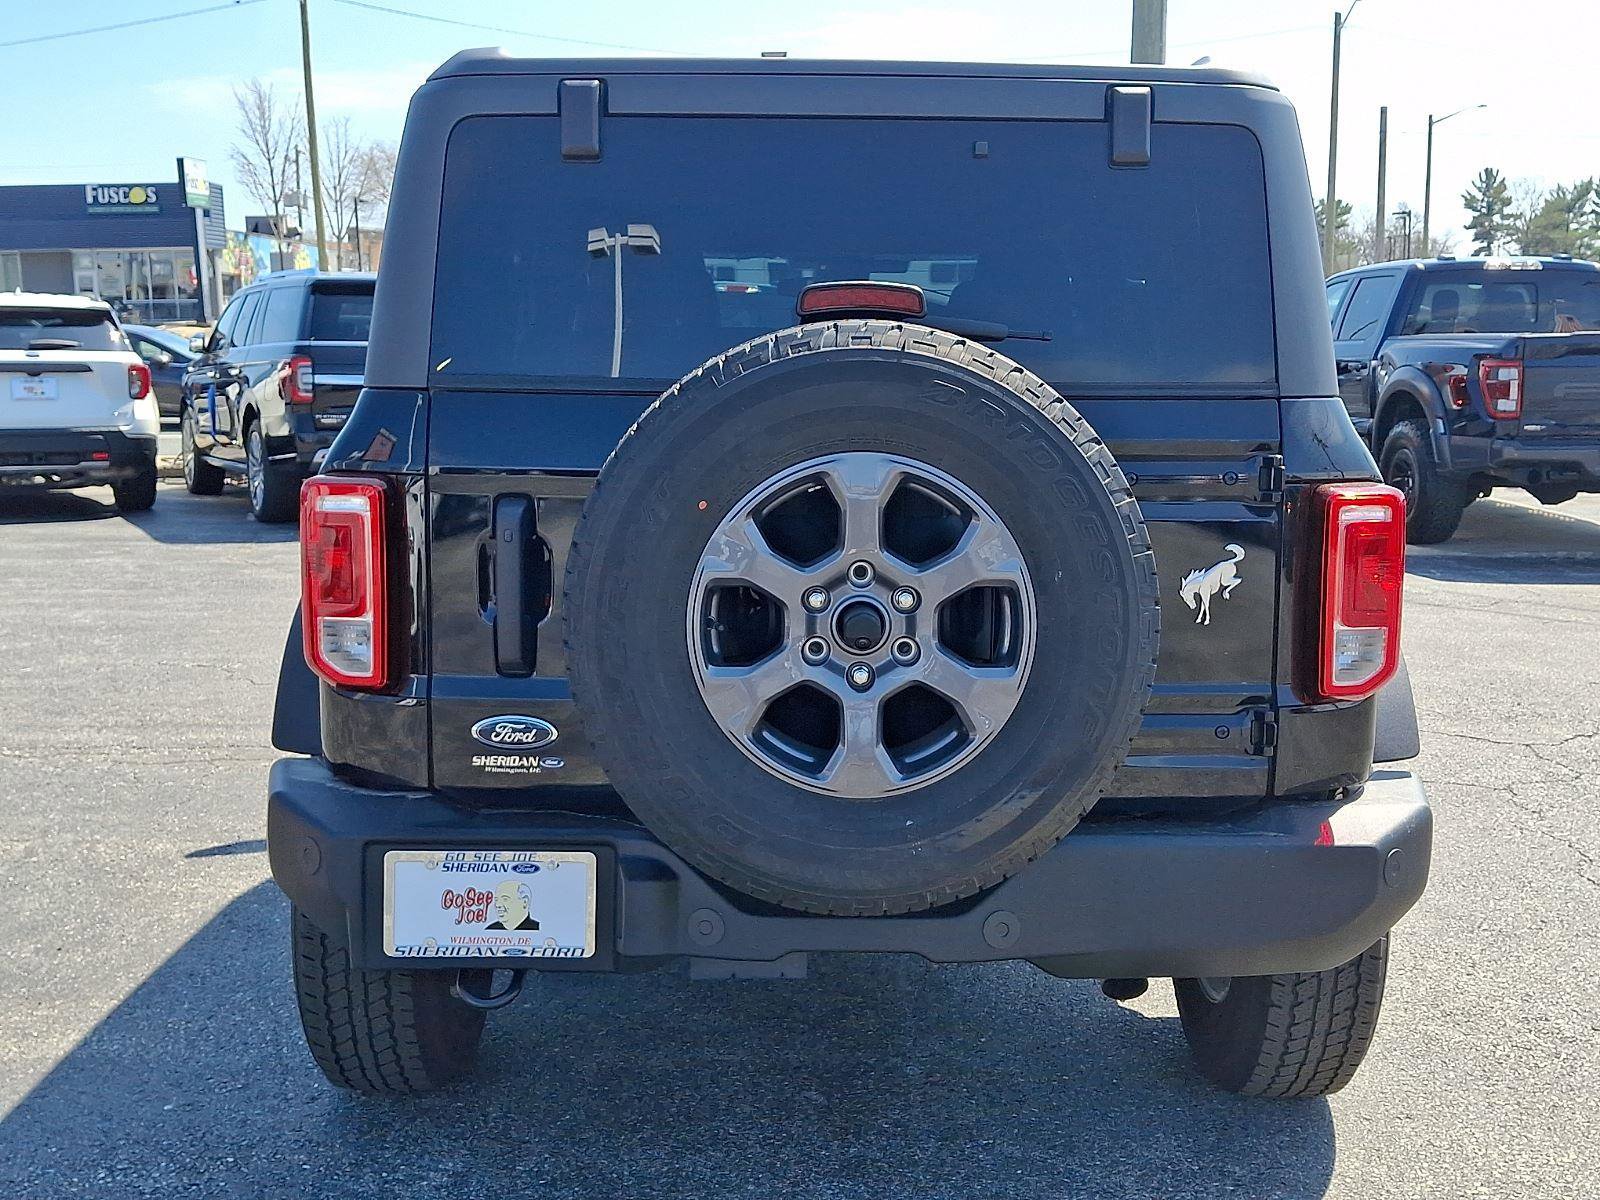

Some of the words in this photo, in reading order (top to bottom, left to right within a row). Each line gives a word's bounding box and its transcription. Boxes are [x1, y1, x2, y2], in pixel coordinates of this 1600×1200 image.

[920, 378, 1124, 742] BRIDGESTONE
[490, 722, 537, 742] Ford
[471, 755, 539, 767] SHERIDAN
[445, 853, 465, 862] GO
[474, 853, 501, 862] SEE
[512, 853, 537, 862] JOE
[441, 863, 509, 873] SHERIDAN
[441, 889, 464, 910] Go
[464, 887, 494, 908] See
[455, 903, 489, 925] Joe!
[517, 936, 532, 945] DE
[395, 945, 500, 957] SHERIDAN
[530, 947, 585, 957] FORD
